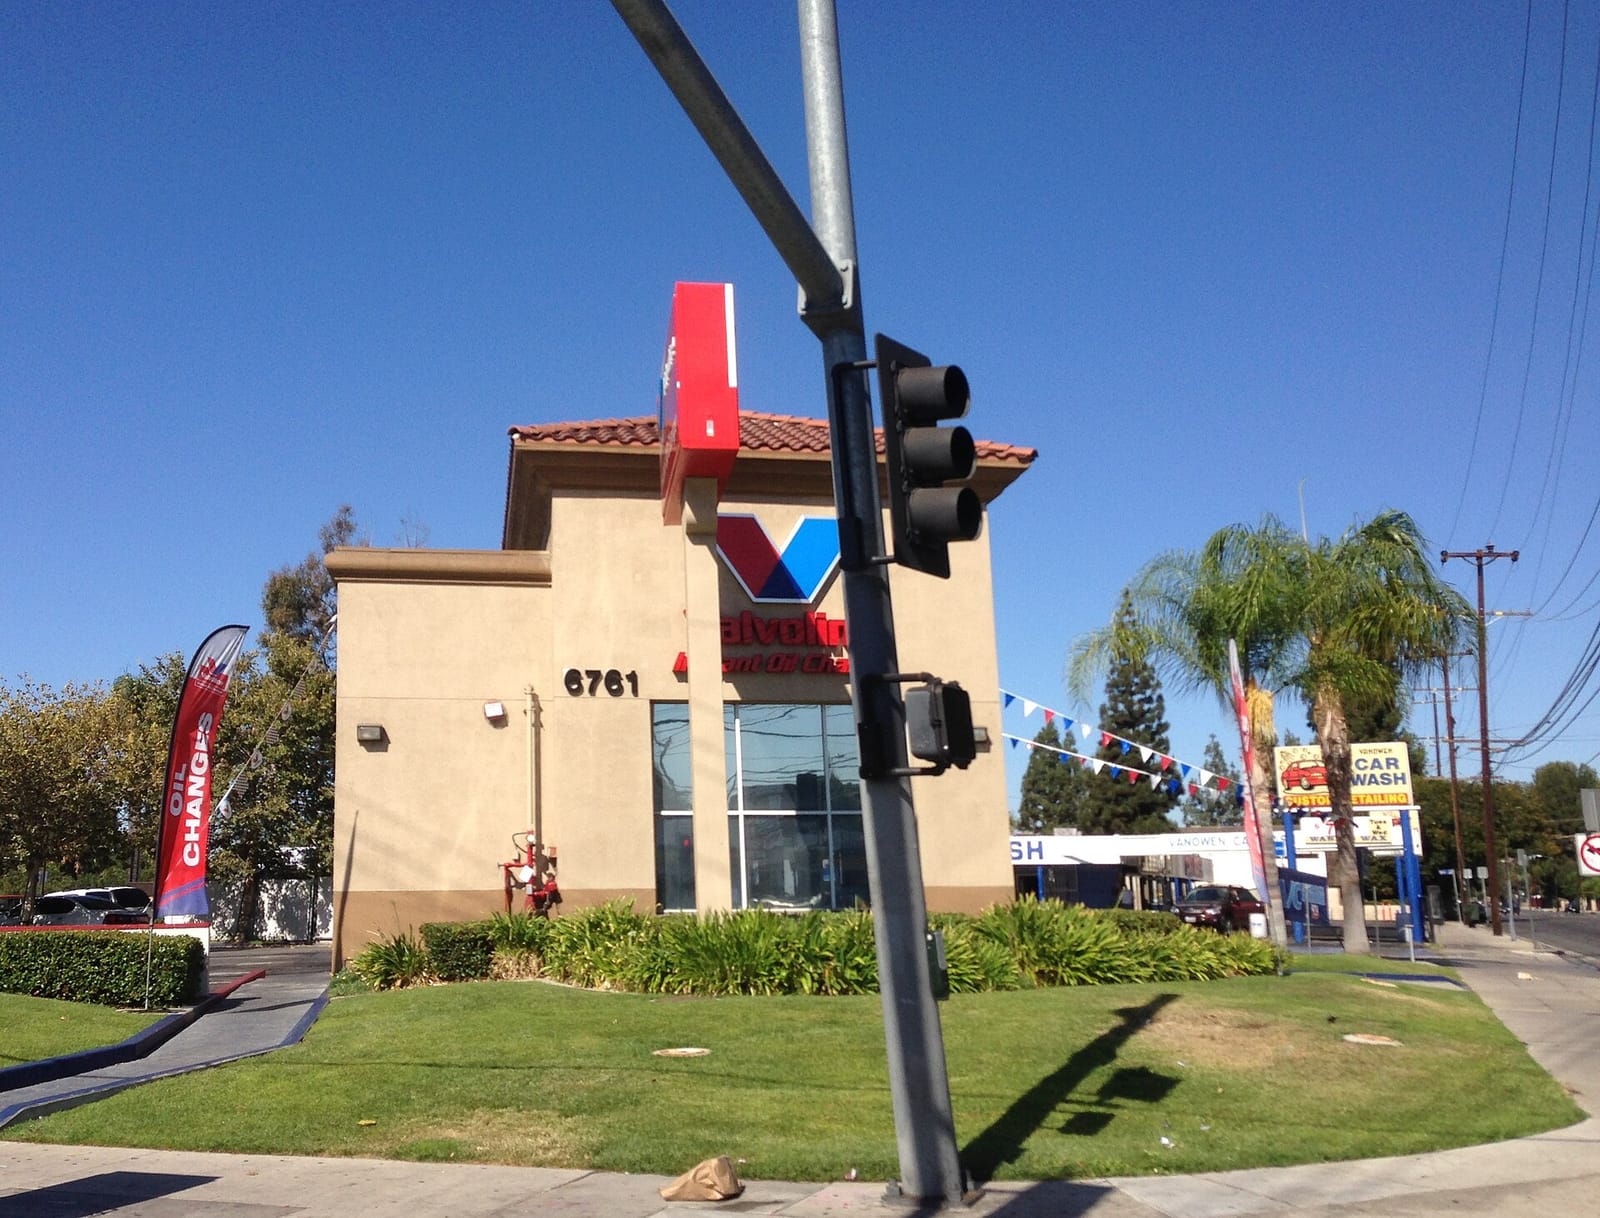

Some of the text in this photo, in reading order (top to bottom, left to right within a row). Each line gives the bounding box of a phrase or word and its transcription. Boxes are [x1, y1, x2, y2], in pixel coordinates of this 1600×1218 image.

[683, 610, 848, 646] alvolin
[765, 652, 800, 673] Oil
[802, 652, 851, 673] Cha
[564, 668, 639, 697] 6761
[1354, 757, 1400, 771] CAR
[182, 711, 214, 867] CHANGES
[1351, 772, 1407, 786] WASH
[169, 762, 187, 817] OIL
[1285, 793, 1407, 807] CUSTO ETAILING
[1010, 841, 1044, 860] SH
[1169, 836, 1249, 847] VANOWEN CA
